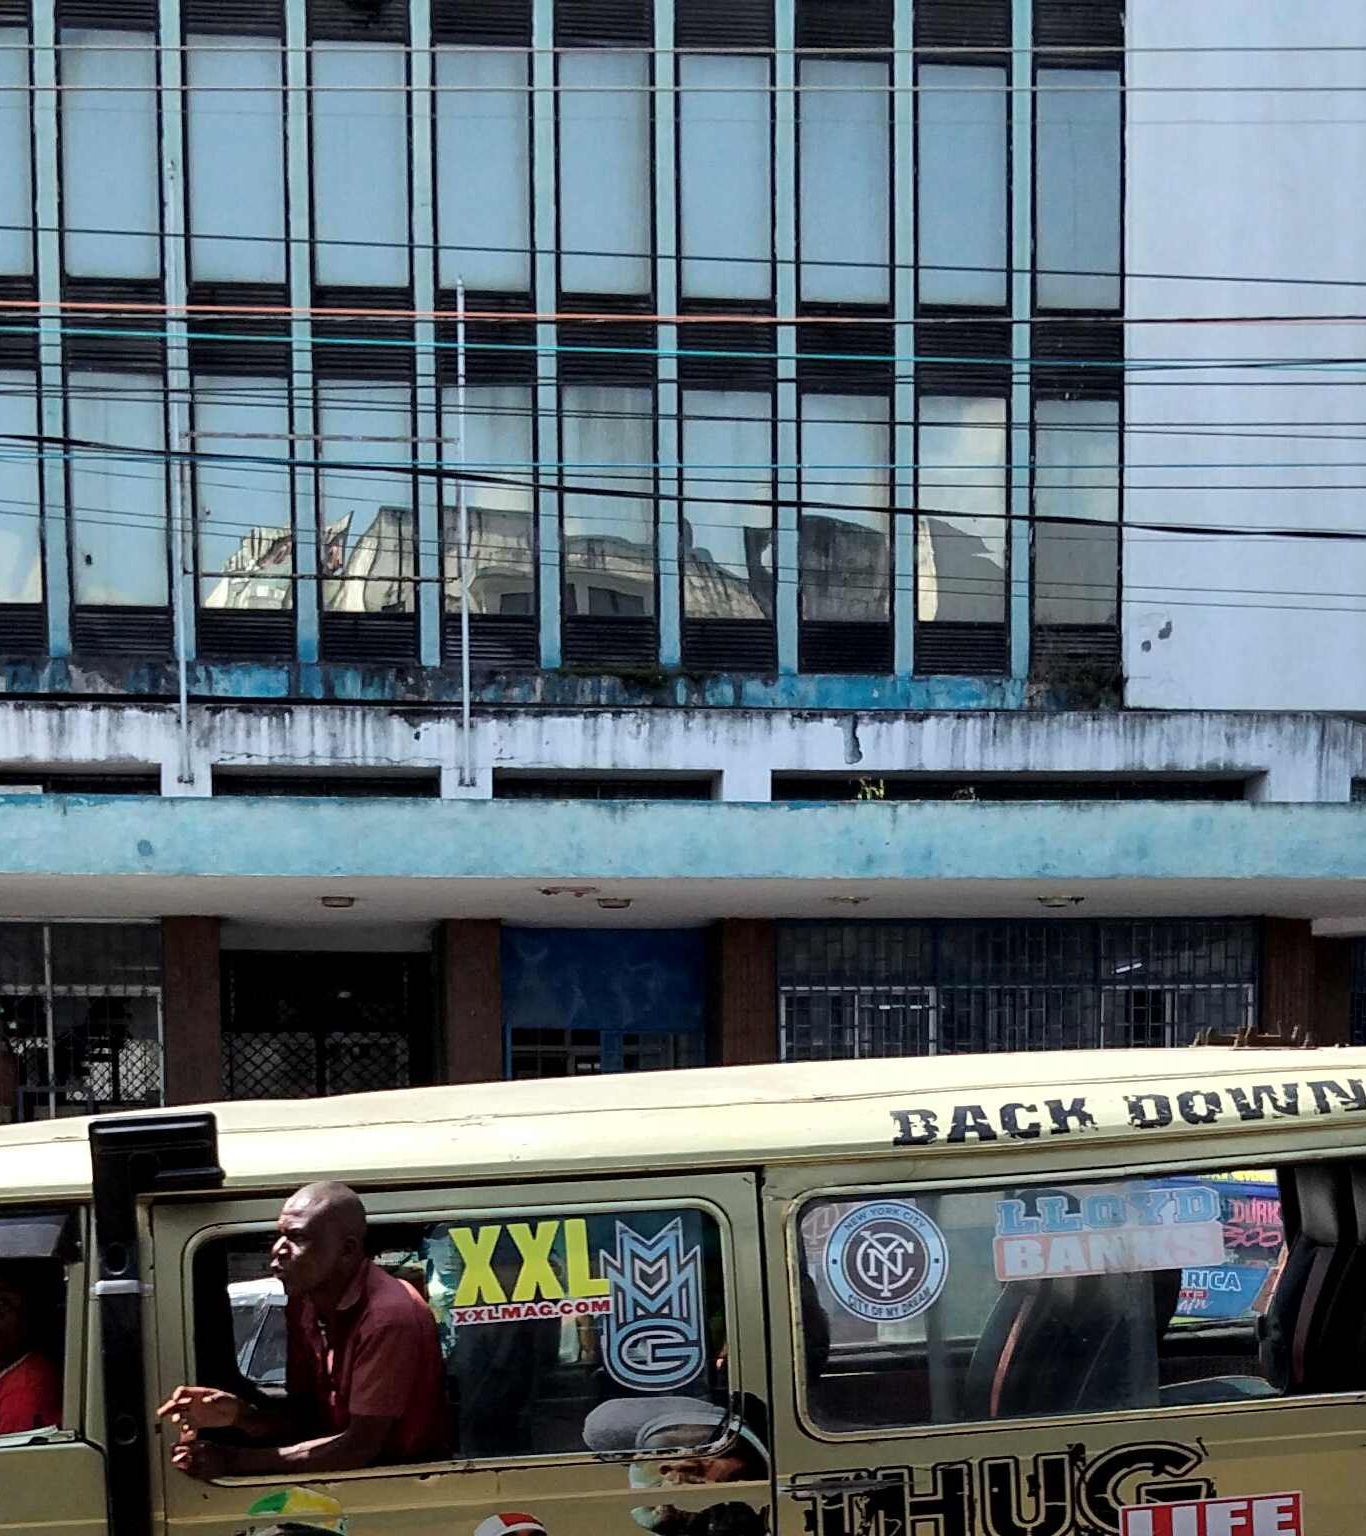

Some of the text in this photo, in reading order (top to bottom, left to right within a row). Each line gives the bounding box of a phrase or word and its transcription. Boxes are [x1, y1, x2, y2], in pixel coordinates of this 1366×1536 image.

[890, 1097, 1099, 1146] BACK
[844, 1211, 867, 1231] NEW
[870, 1206, 901, 1218] YORK
[903, 1210, 926, 1230] CITY
[995, 1186, 1221, 1236] LLOYD
[448, 1219, 610, 1307] XXL
[1001, 1227, 1212, 1277] BANKS
[453, 1299, 611, 1324] XXLMAG.COM
[847, 1294, 868, 1313] CITY
[871, 1305, 884, 1316] OF
[887, 1305, 900, 1316] MY
